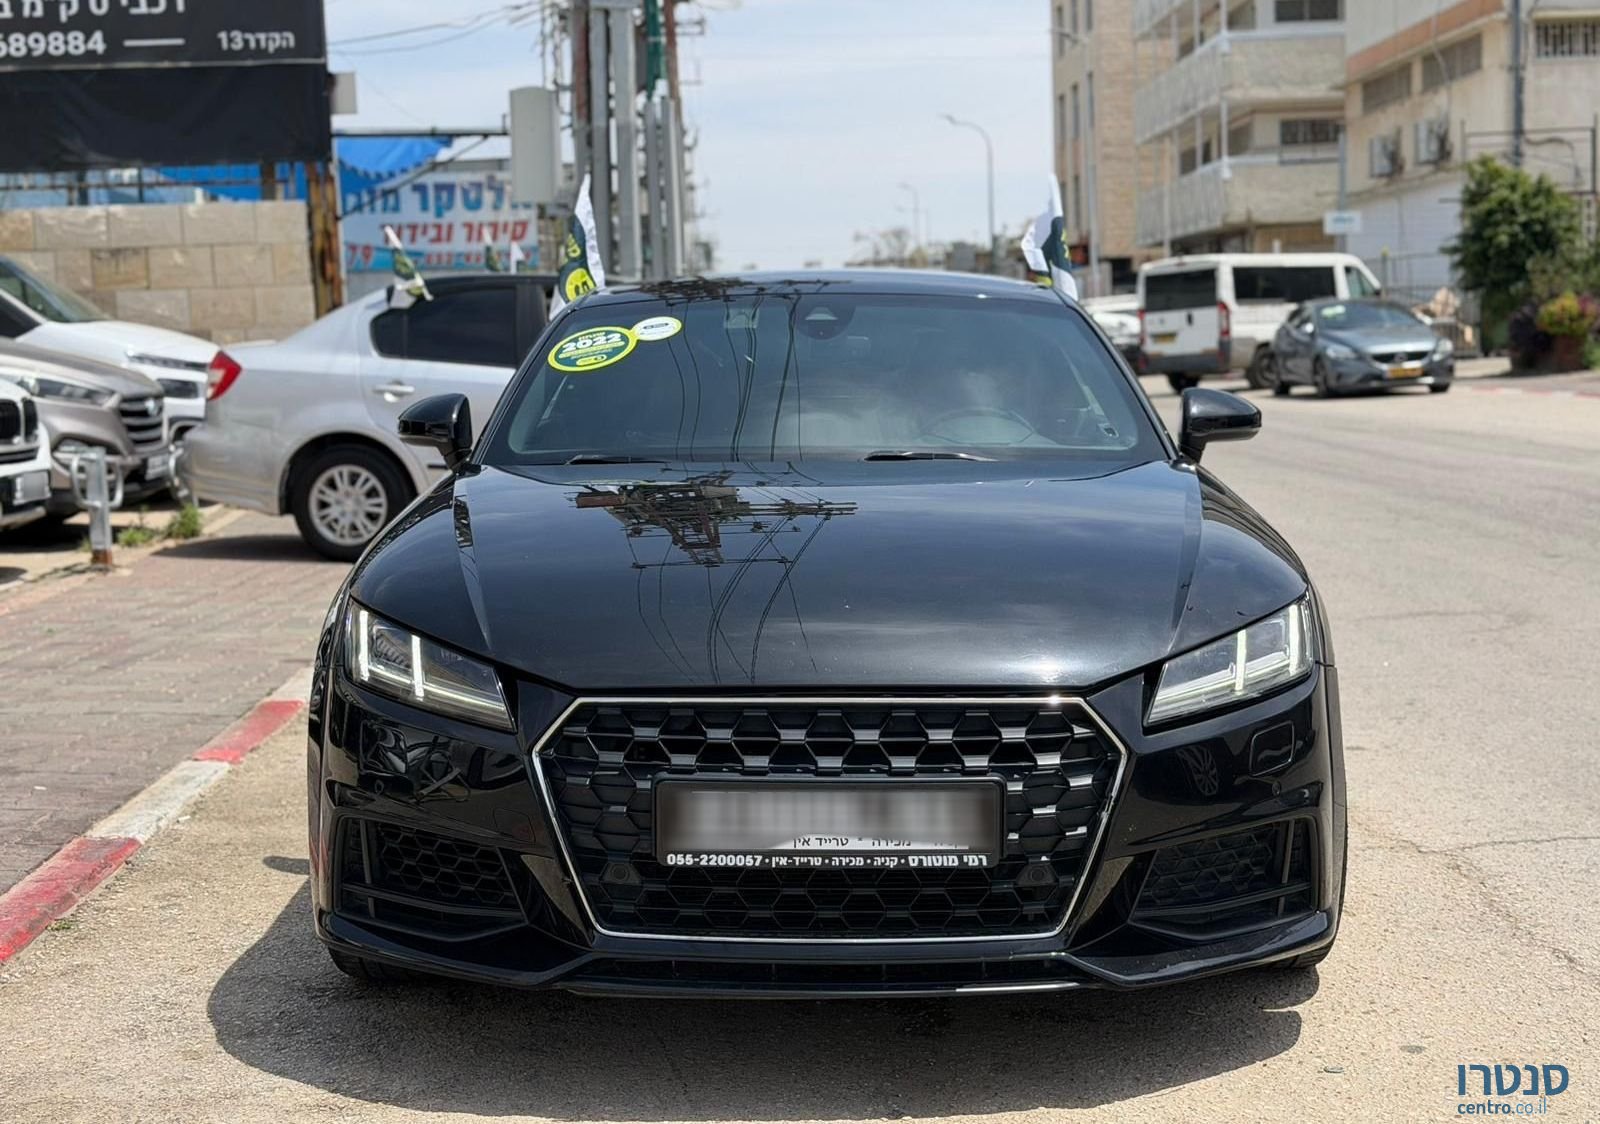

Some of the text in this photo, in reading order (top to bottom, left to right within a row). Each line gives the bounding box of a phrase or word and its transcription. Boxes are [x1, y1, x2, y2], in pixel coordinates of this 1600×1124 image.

[561, 333, 622, 353] 2022
[666, 853, 988, 868] רמי מוטורס קניה מכירה טרייד-אין 055-2200057
